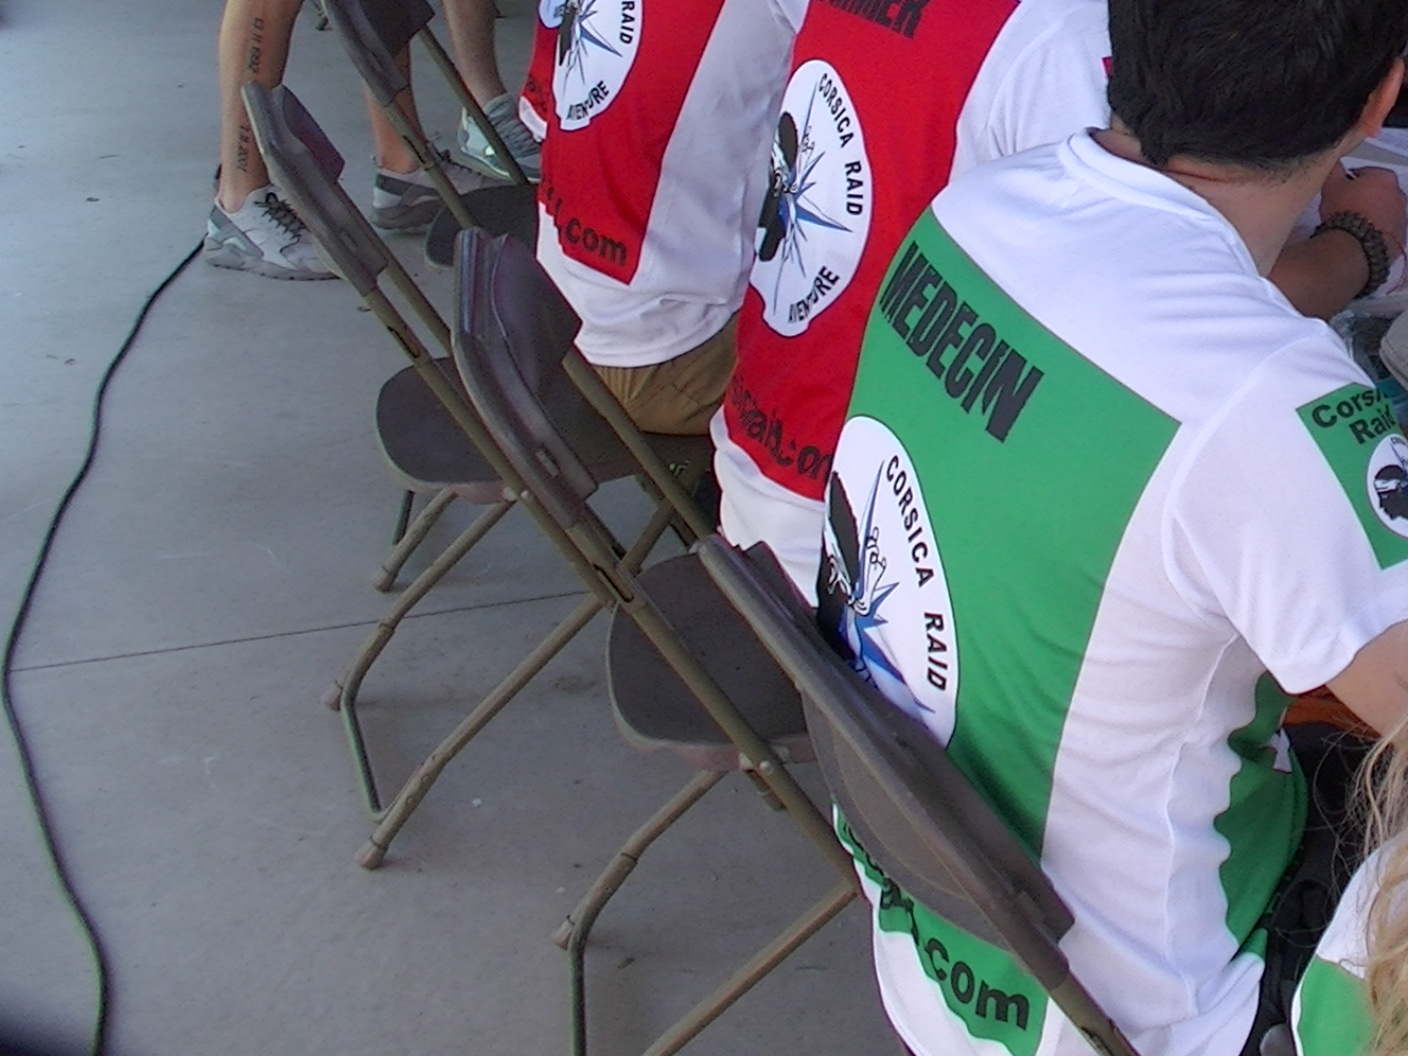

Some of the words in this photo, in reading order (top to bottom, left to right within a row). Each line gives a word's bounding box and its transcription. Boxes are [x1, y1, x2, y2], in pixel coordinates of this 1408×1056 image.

[619, 0, 636, 45] RAID
[817, 72, 855, 148] CORSICA
[844, 160, 864, 216] RAID
[880, 241, 1044, 444] MEDECIN
[1311, 388, 1388, 428] Cors
[885, 455, 934, 588] CORSICA
[923, 611, 948, 692] RAID
